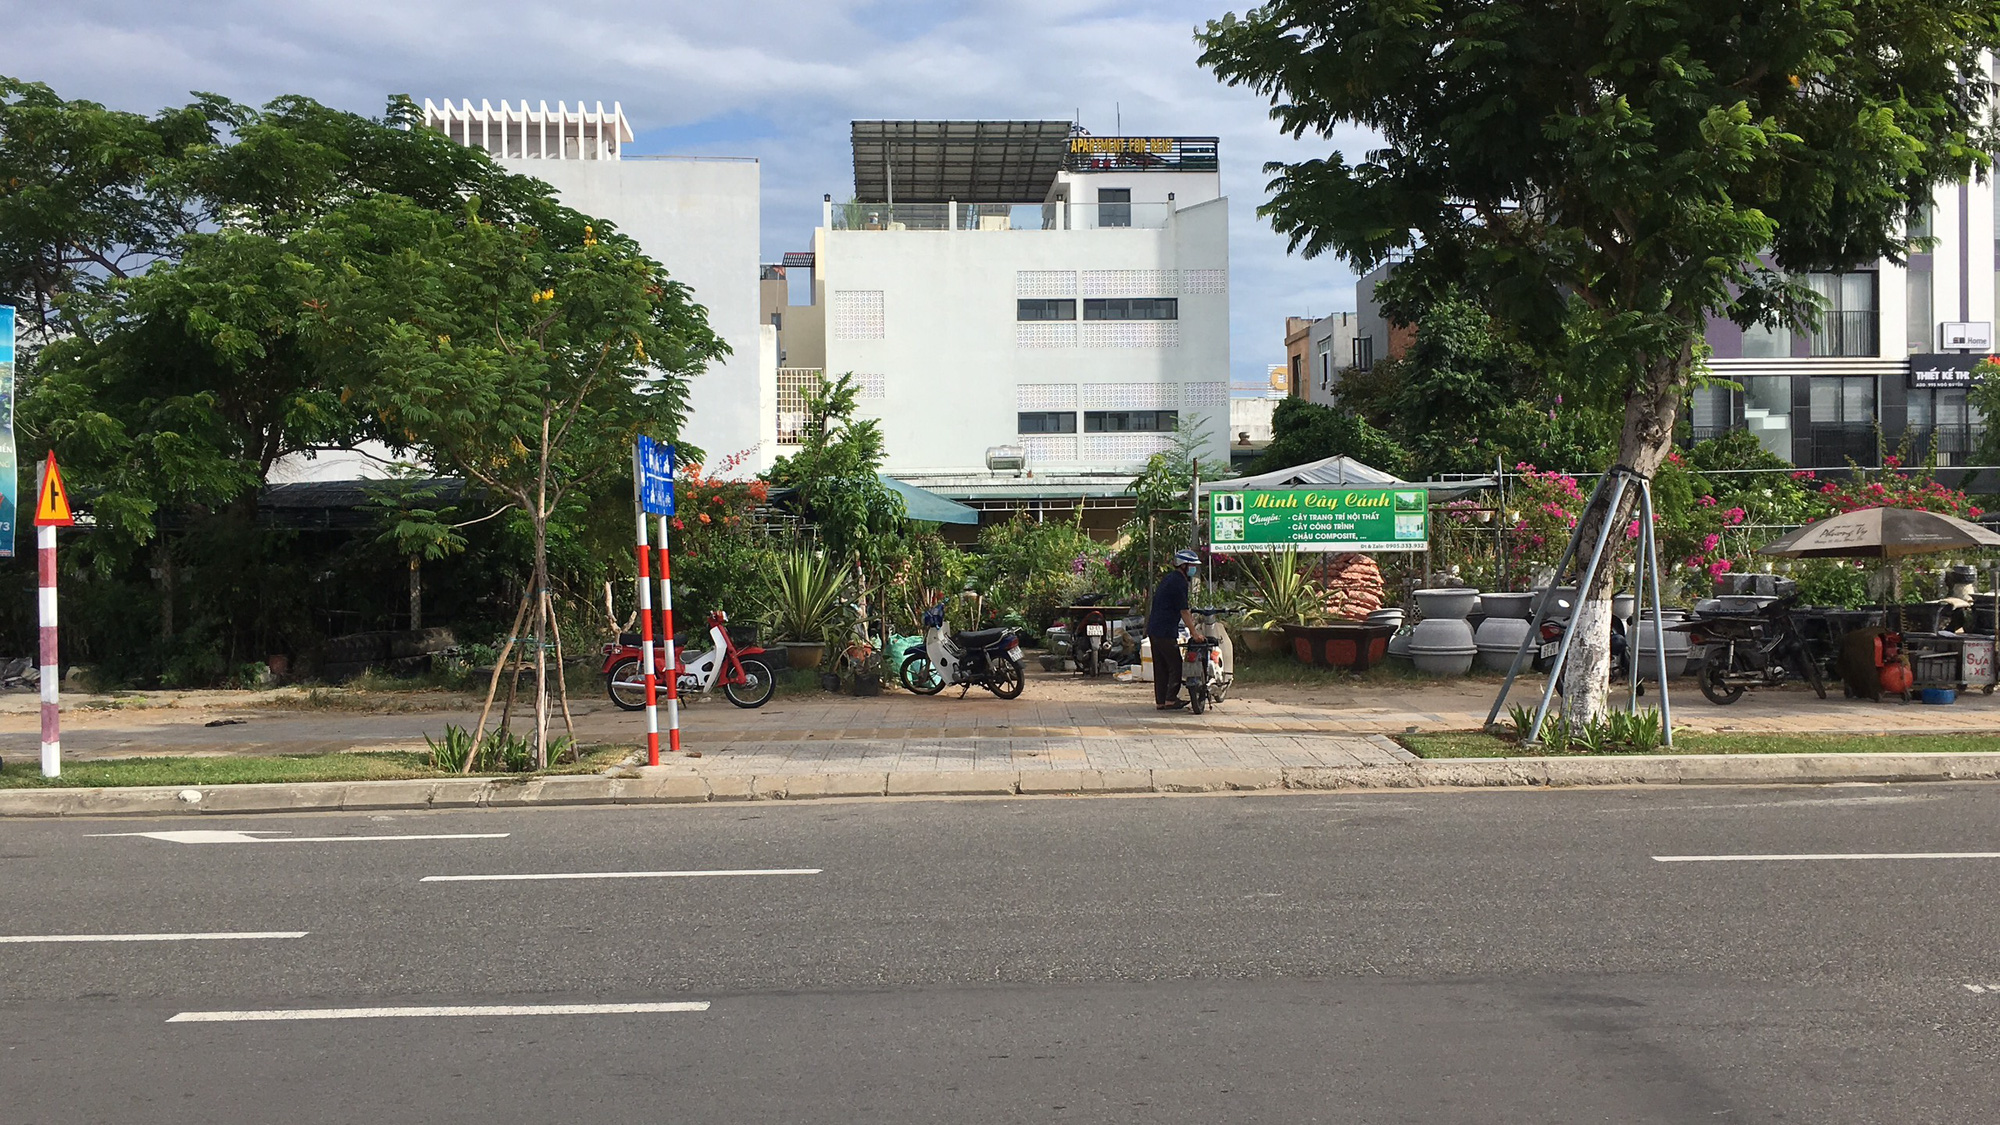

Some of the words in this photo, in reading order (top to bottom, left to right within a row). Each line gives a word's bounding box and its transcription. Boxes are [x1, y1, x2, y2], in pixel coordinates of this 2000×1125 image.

[1071, 138, 1125, 153] APARTMENT
[1128, 138, 1147, 153] FOR
[1150, 138, 1174, 153] RENT
[1915, 367, 1940, 380] THIẾT
[1942, 367, 1955, 380] KẾ
[1249, 493, 1299, 508] Minh
[1304, 492, 1339, 511] Cây
[1292, 512, 1308, 521] CÂY
[1309, 513, 1333, 521] TRANG
[1335, 512, 1346, 521] TRÍ
[1347, 512, 1361, 522] NỘI
[1361, 511, 1380, 520] THẤT
[1292, 522, 1308, 530] CÂY
[1309, 522, 1333, 530] CÔNG
[1333, 522, 1355, 530] TRÌNH
[1292, 532, 1314, 542] CHẬU
[1315, 532, 1358, 541] COMPOSITE,
[1974, 667, 1986, 676] XE
